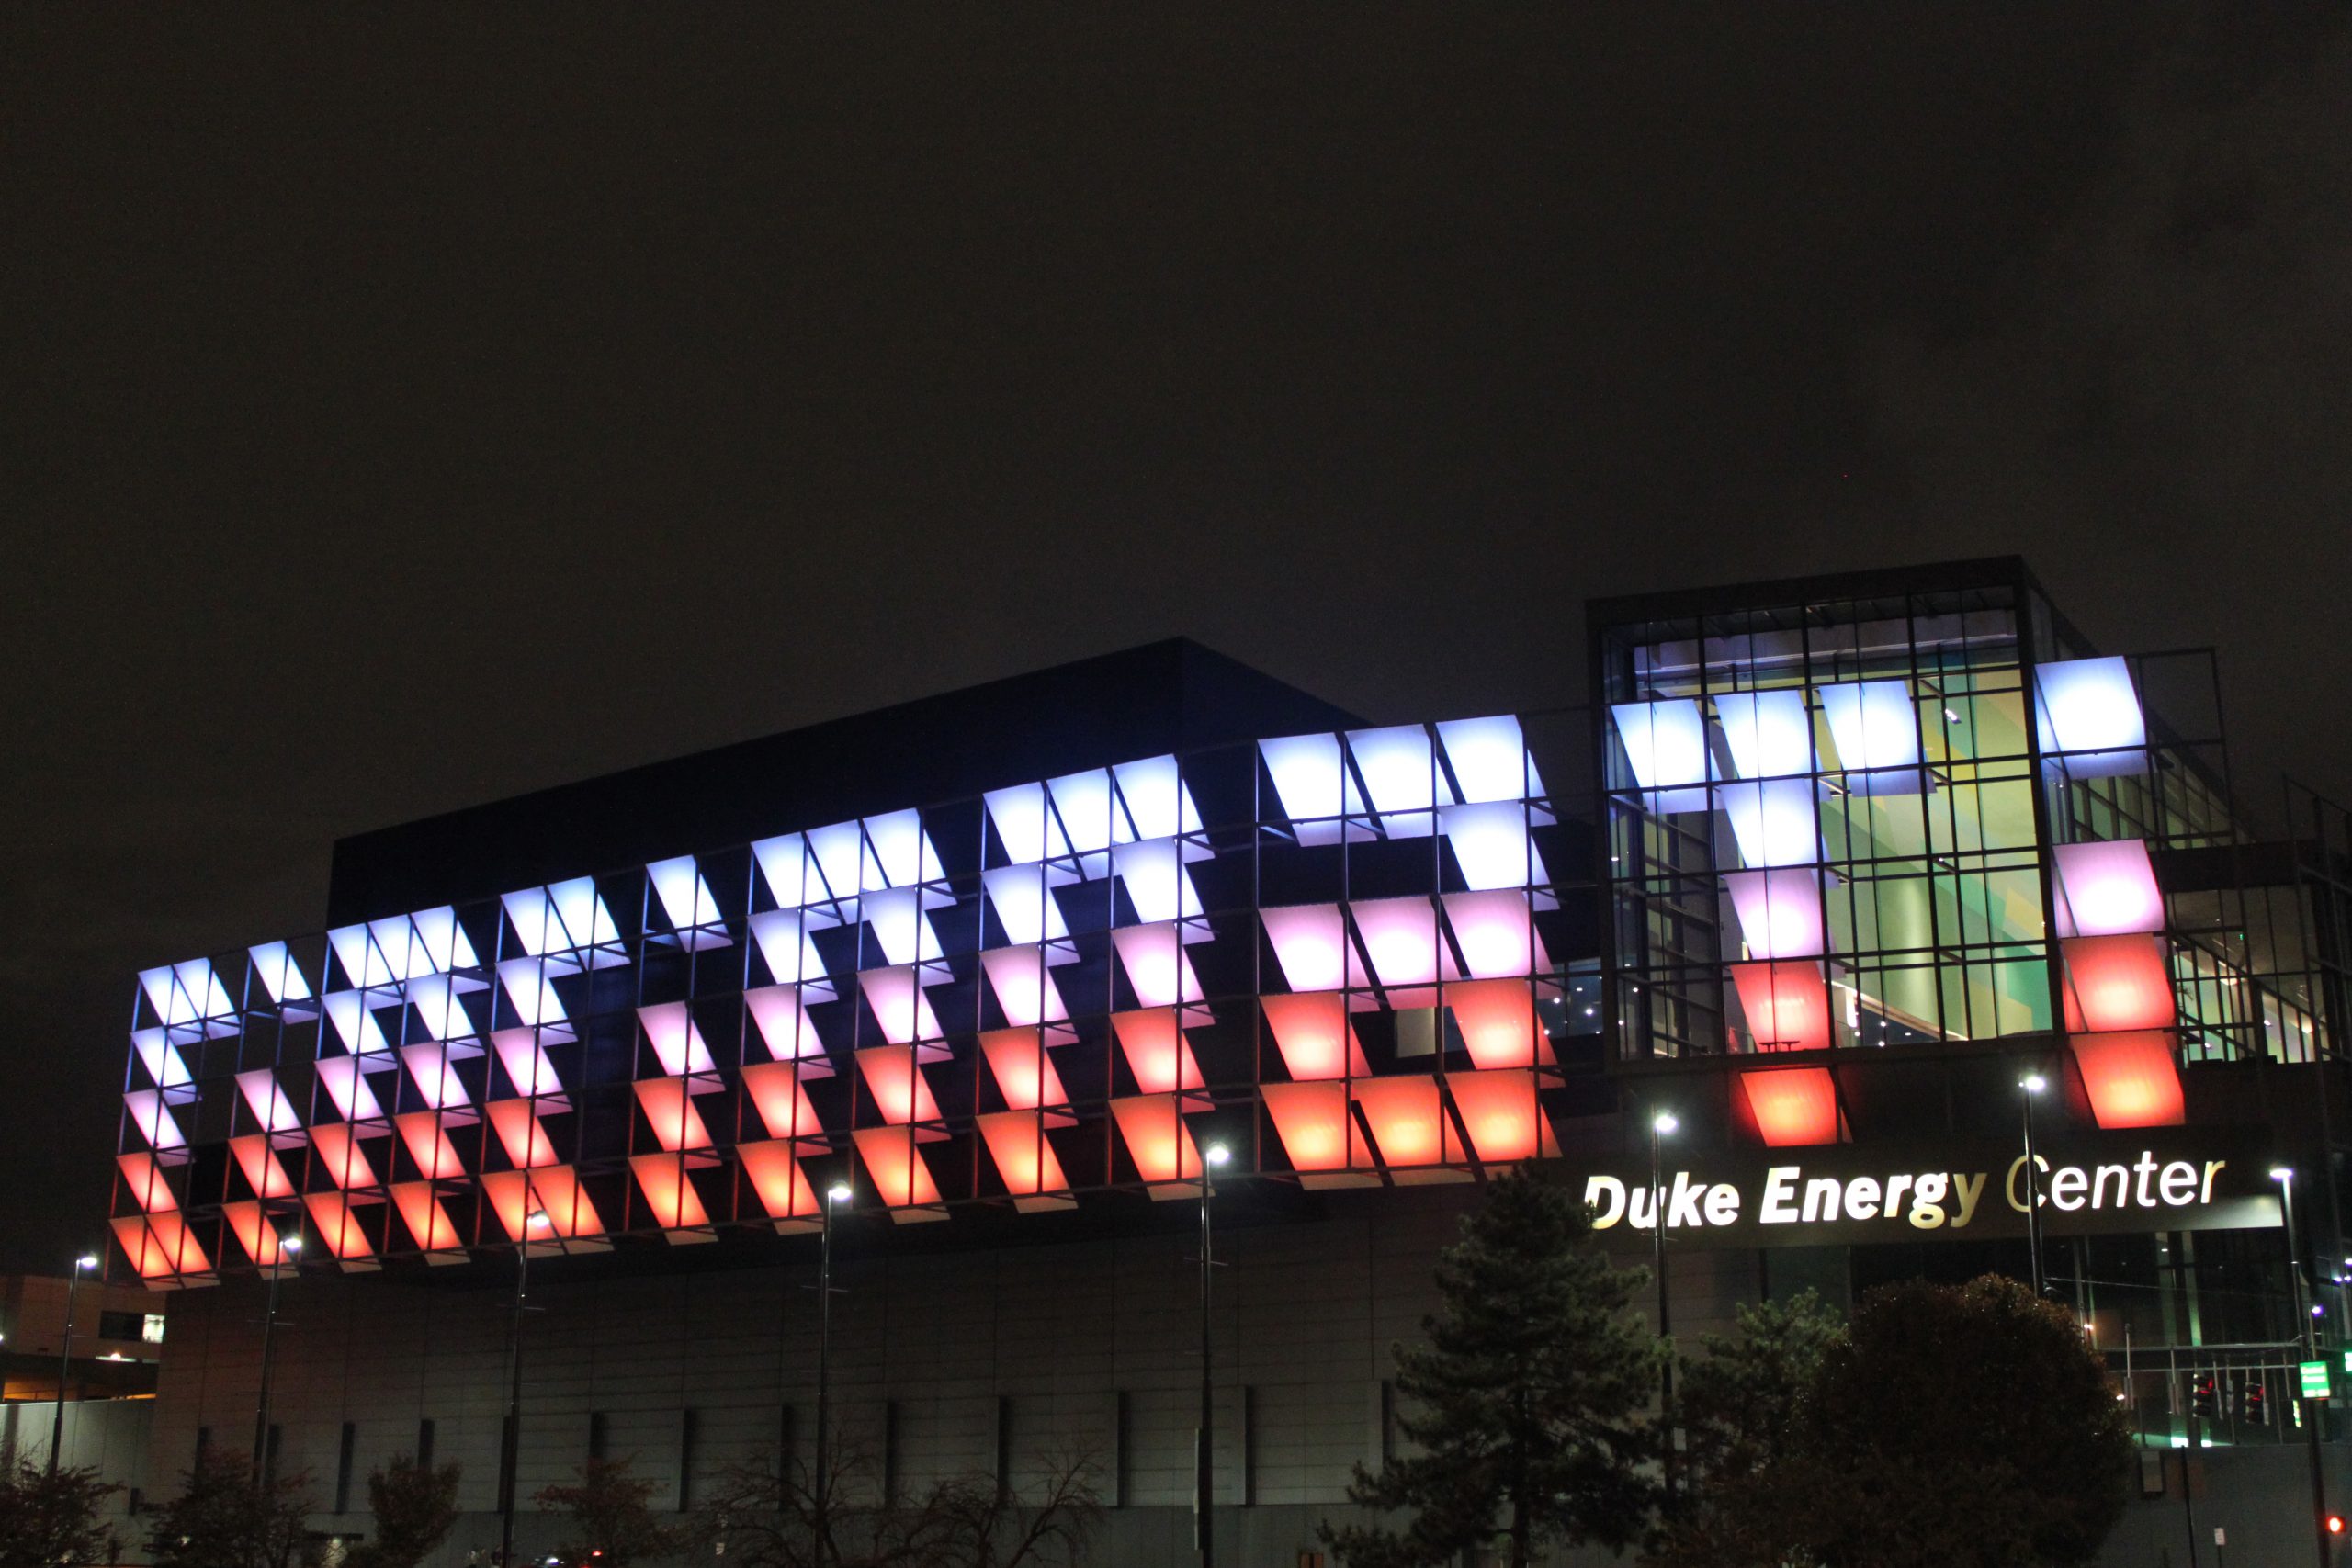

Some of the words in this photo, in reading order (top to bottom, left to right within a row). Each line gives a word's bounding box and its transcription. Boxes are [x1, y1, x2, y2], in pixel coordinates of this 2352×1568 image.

[1583, 1171, 1740, 1230] Duke
[1759, 1166, 1988, 1229] Energy
[2006, 1151, 2226, 1213] Center
